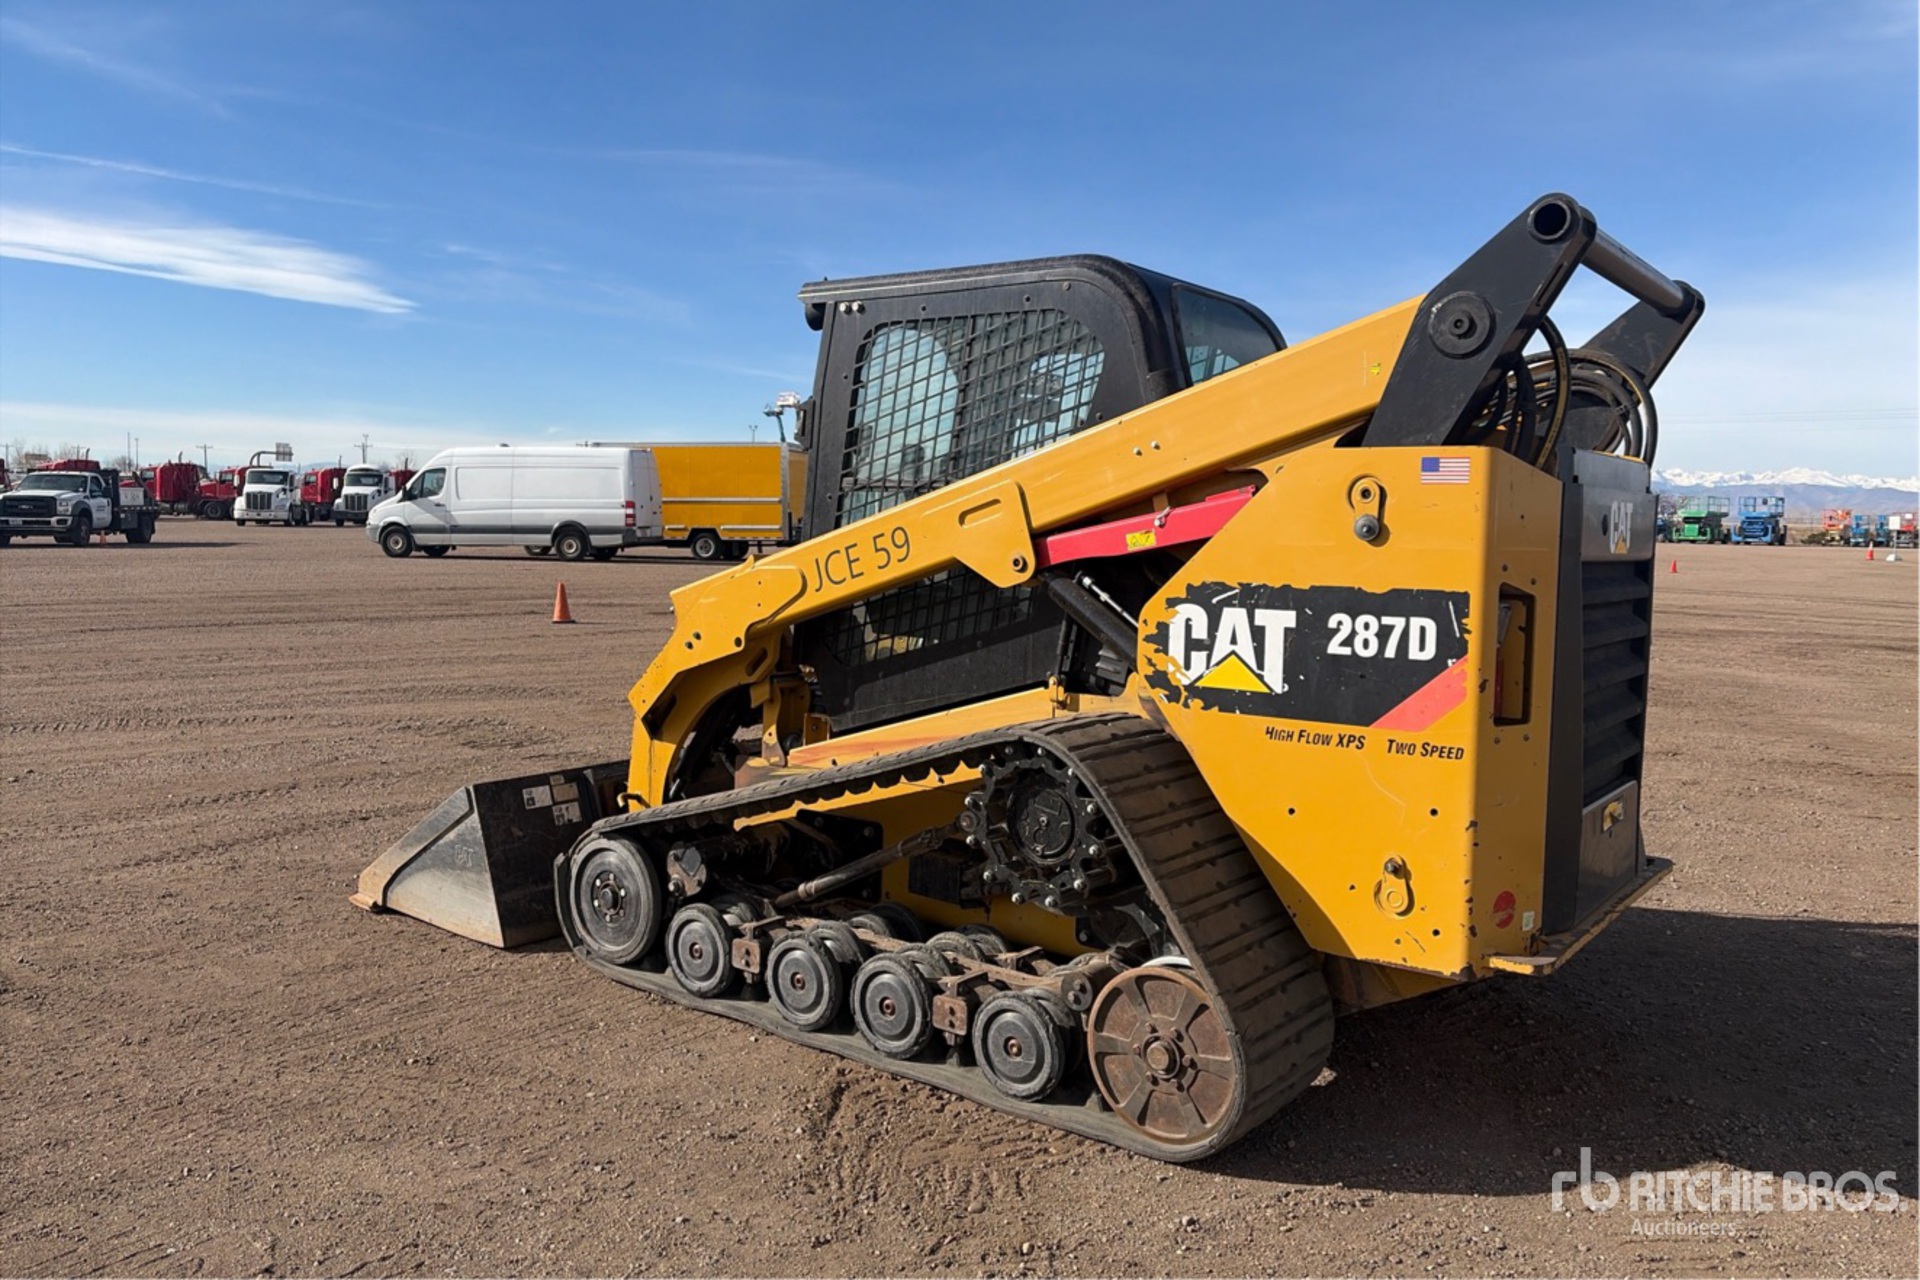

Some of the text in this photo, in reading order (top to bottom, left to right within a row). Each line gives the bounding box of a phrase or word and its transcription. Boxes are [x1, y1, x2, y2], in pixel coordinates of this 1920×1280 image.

[1610, 501, 1633, 554] CAT
[815, 526, 910, 592] JCE 59
[1168, 603, 1297, 694] CAT
[1327, 612, 1438, 660] 287D
[1297, 729, 1333, 747] FLOW
[1335, 733, 1366, 750] XPS
[1387, 739, 1465, 760] TWO SPEED
